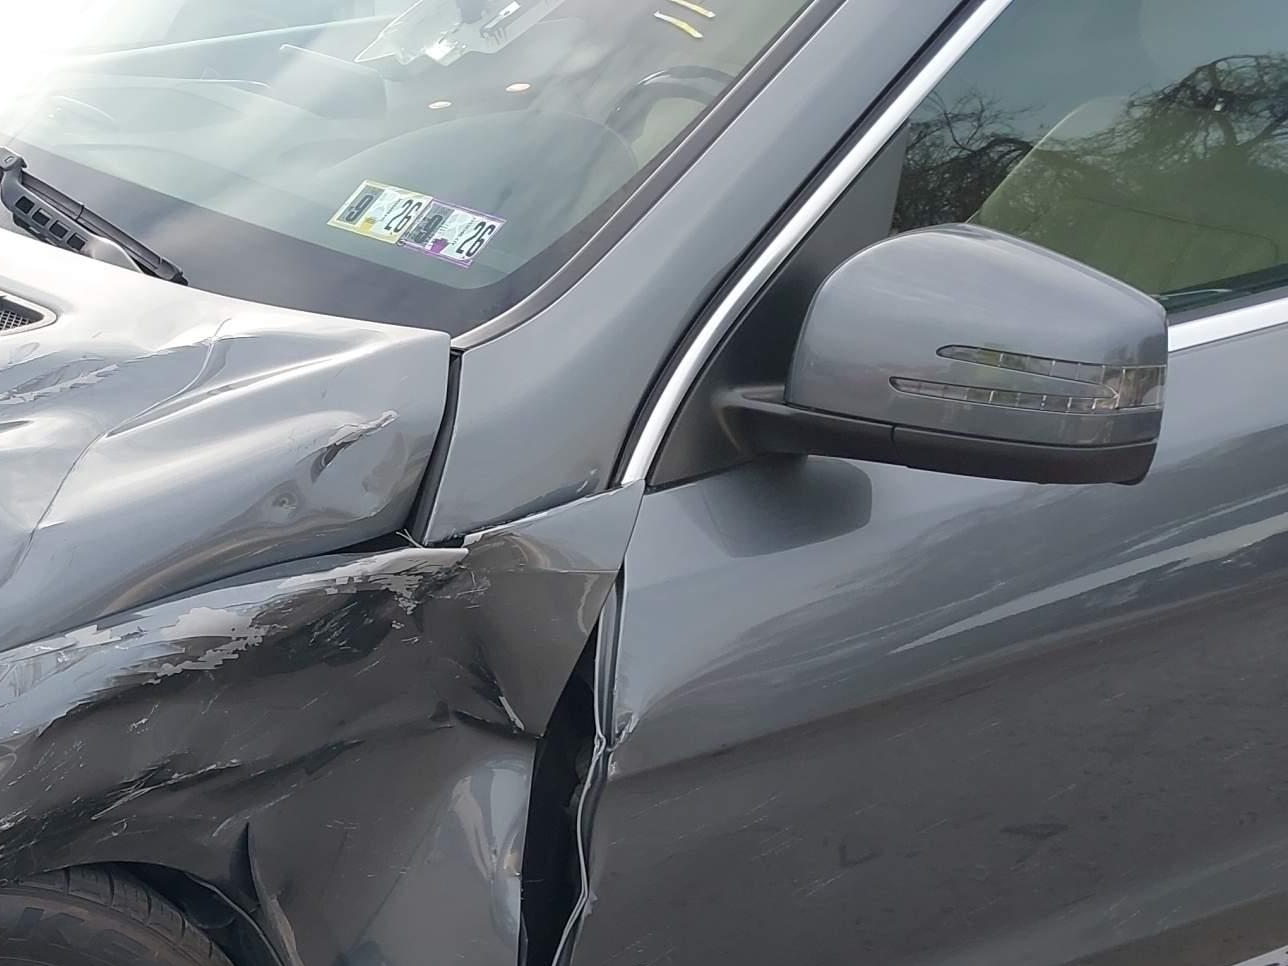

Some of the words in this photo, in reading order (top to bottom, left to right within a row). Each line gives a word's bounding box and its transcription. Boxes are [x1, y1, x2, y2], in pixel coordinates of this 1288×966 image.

[345, 194, 375, 223] 9
[384, 199, 423, 233] 26
[456, 221, 496, 257] 26
